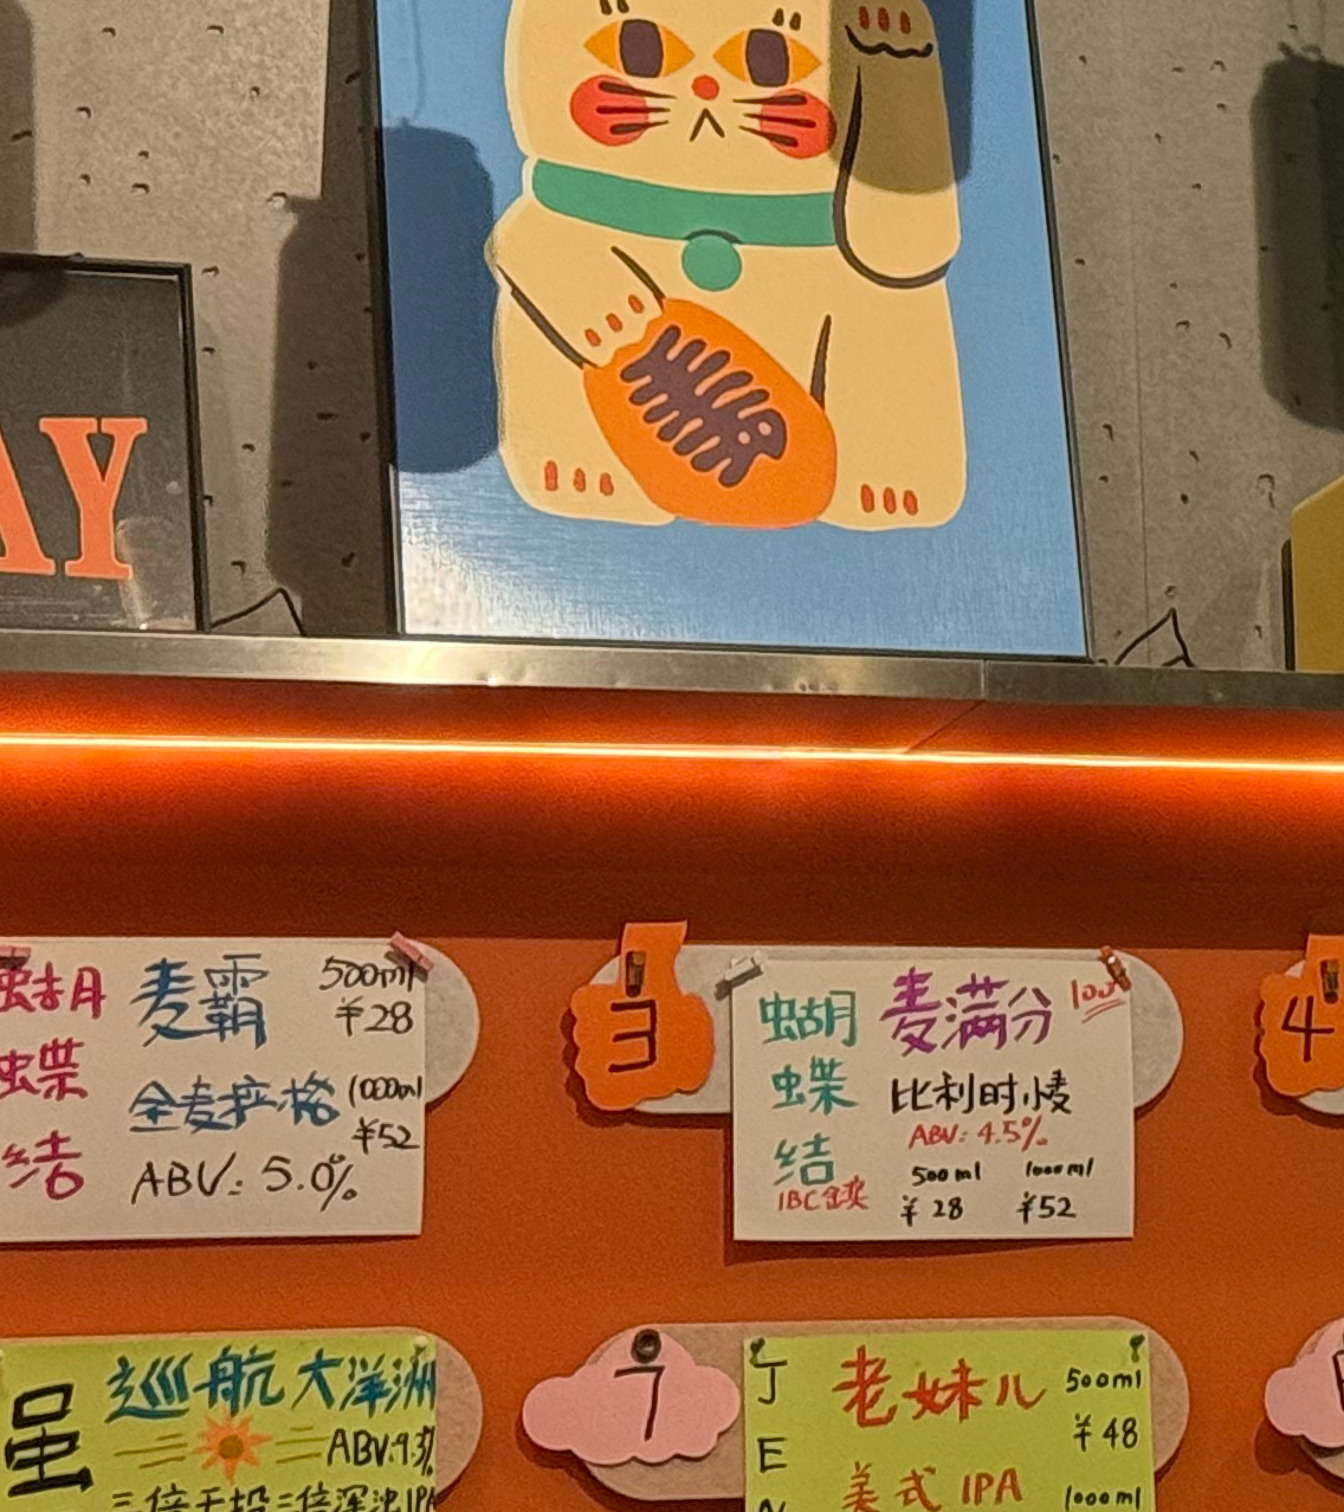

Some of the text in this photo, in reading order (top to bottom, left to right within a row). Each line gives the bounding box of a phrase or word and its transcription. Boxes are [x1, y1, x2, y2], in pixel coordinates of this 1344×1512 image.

[335, 995, 415, 1037] ¥28
[879, 965, 1053, 1057] 麦满分
[1282, 995, 1335, 1063] 4
[759, 990, 859, 1186] 蝴蝶结
[352, 1117, 421, 1155] ¥52
[614, 1364, 665, 1441] 7
[832, 1344, 1047, 1428] 老妹儿
